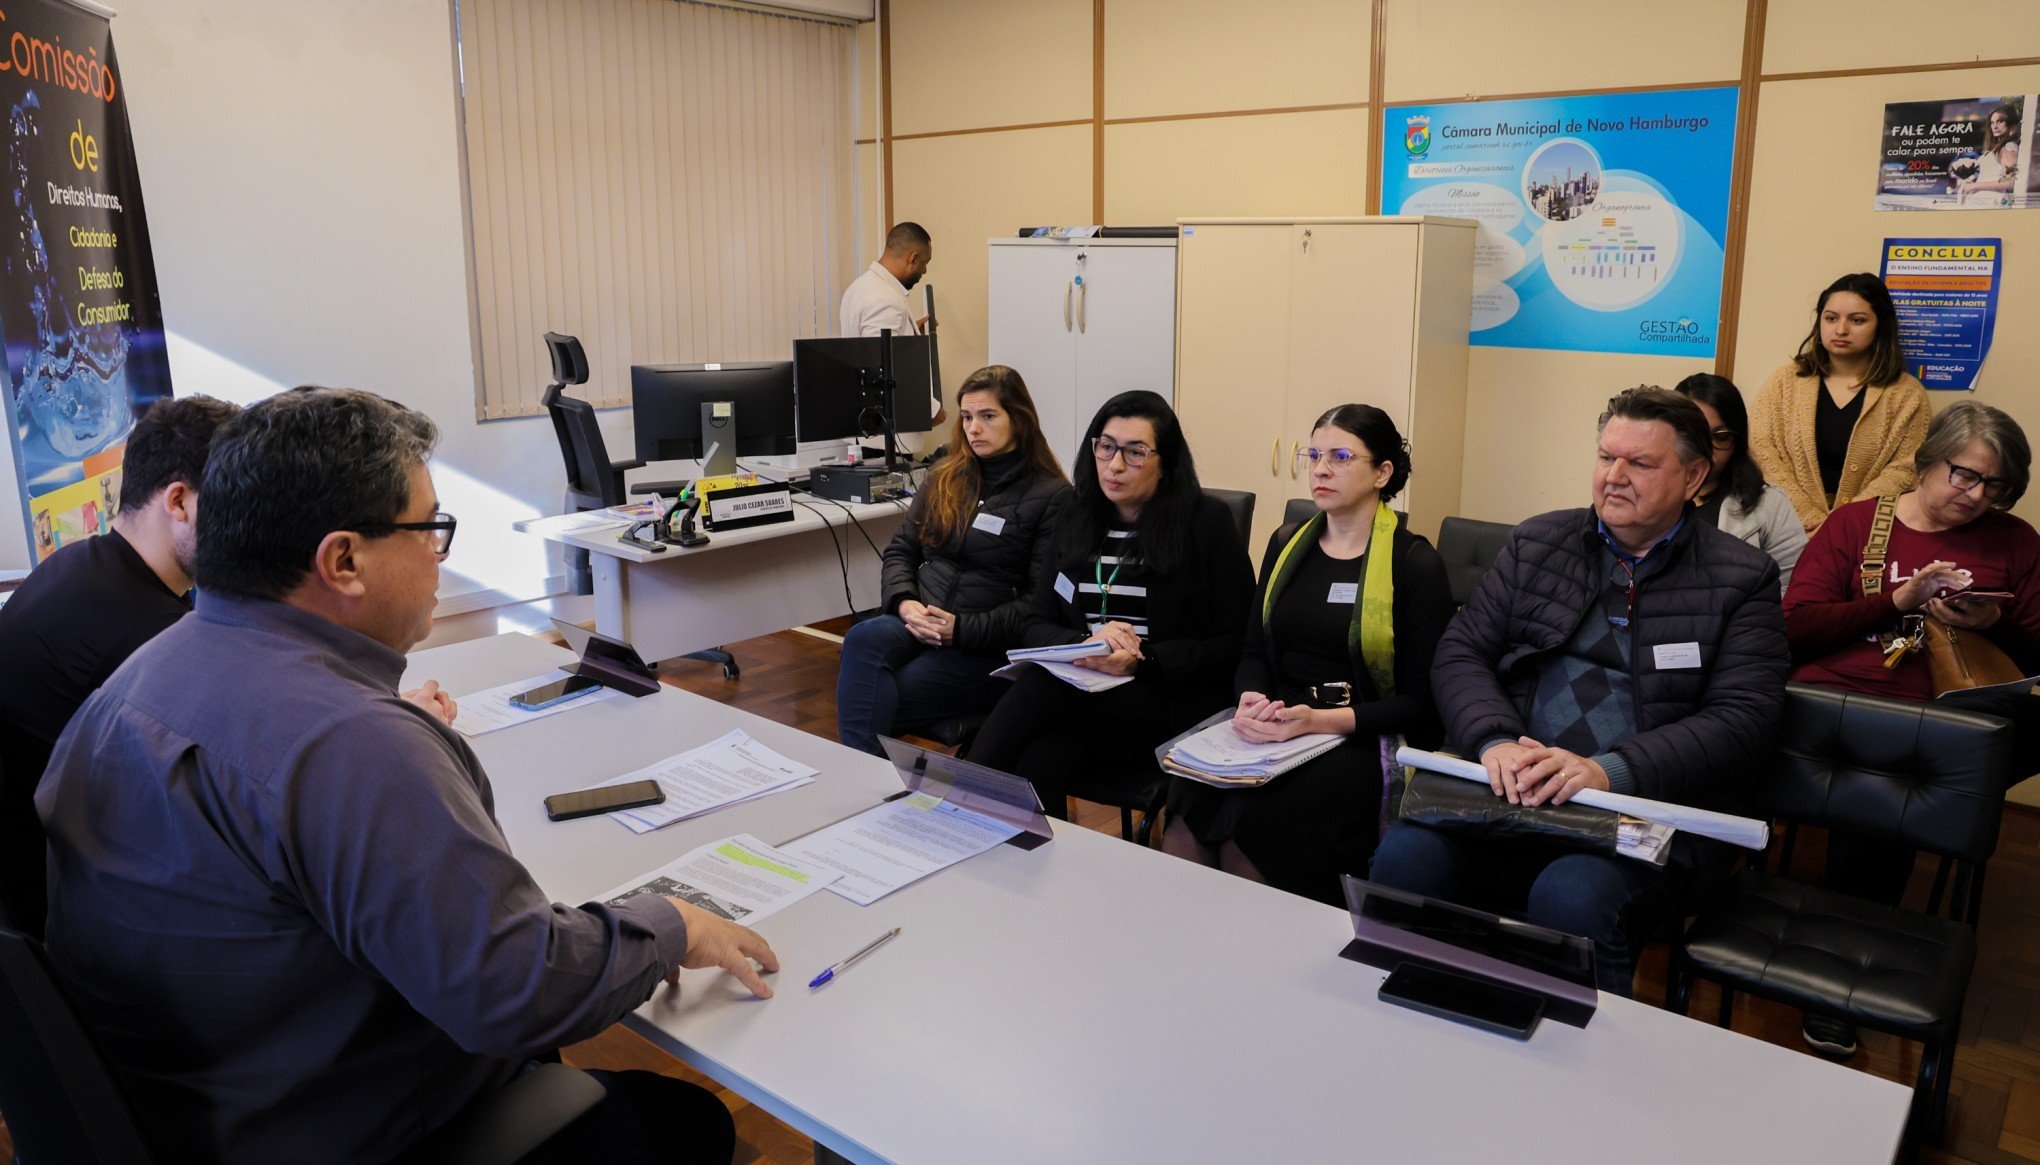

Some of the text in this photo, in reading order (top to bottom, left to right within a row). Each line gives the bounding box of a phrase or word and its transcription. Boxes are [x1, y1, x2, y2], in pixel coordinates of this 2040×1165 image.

[1441, 114, 1709, 139] Câmara Municipal de Novo Hamburgo
[1891, 122, 1974, 136] FALE AGORA
[70, 118, 98, 172] de
[1901, 136, 1961, 147] ou podem te
[1887, 146, 1974, 157] calar para sempre
[1907, 160, 1931, 171] 20%
[48, 181, 122, 213] Direitos Humanos,
[69, 225, 118, 249] Cidadania e
[1894, 248, 1988, 258] CONCLUA
[78, 266, 124, 291] Defesa do
[1910, 299, 1954, 307] GRATUITAS
[1961, 300, 1987, 308] NOITE
[77, 302, 130, 326] Consumidor
[1639, 332, 1710, 344] Compartilhada
[1926, 364, 1965, 372] EDUCAÇÃO
